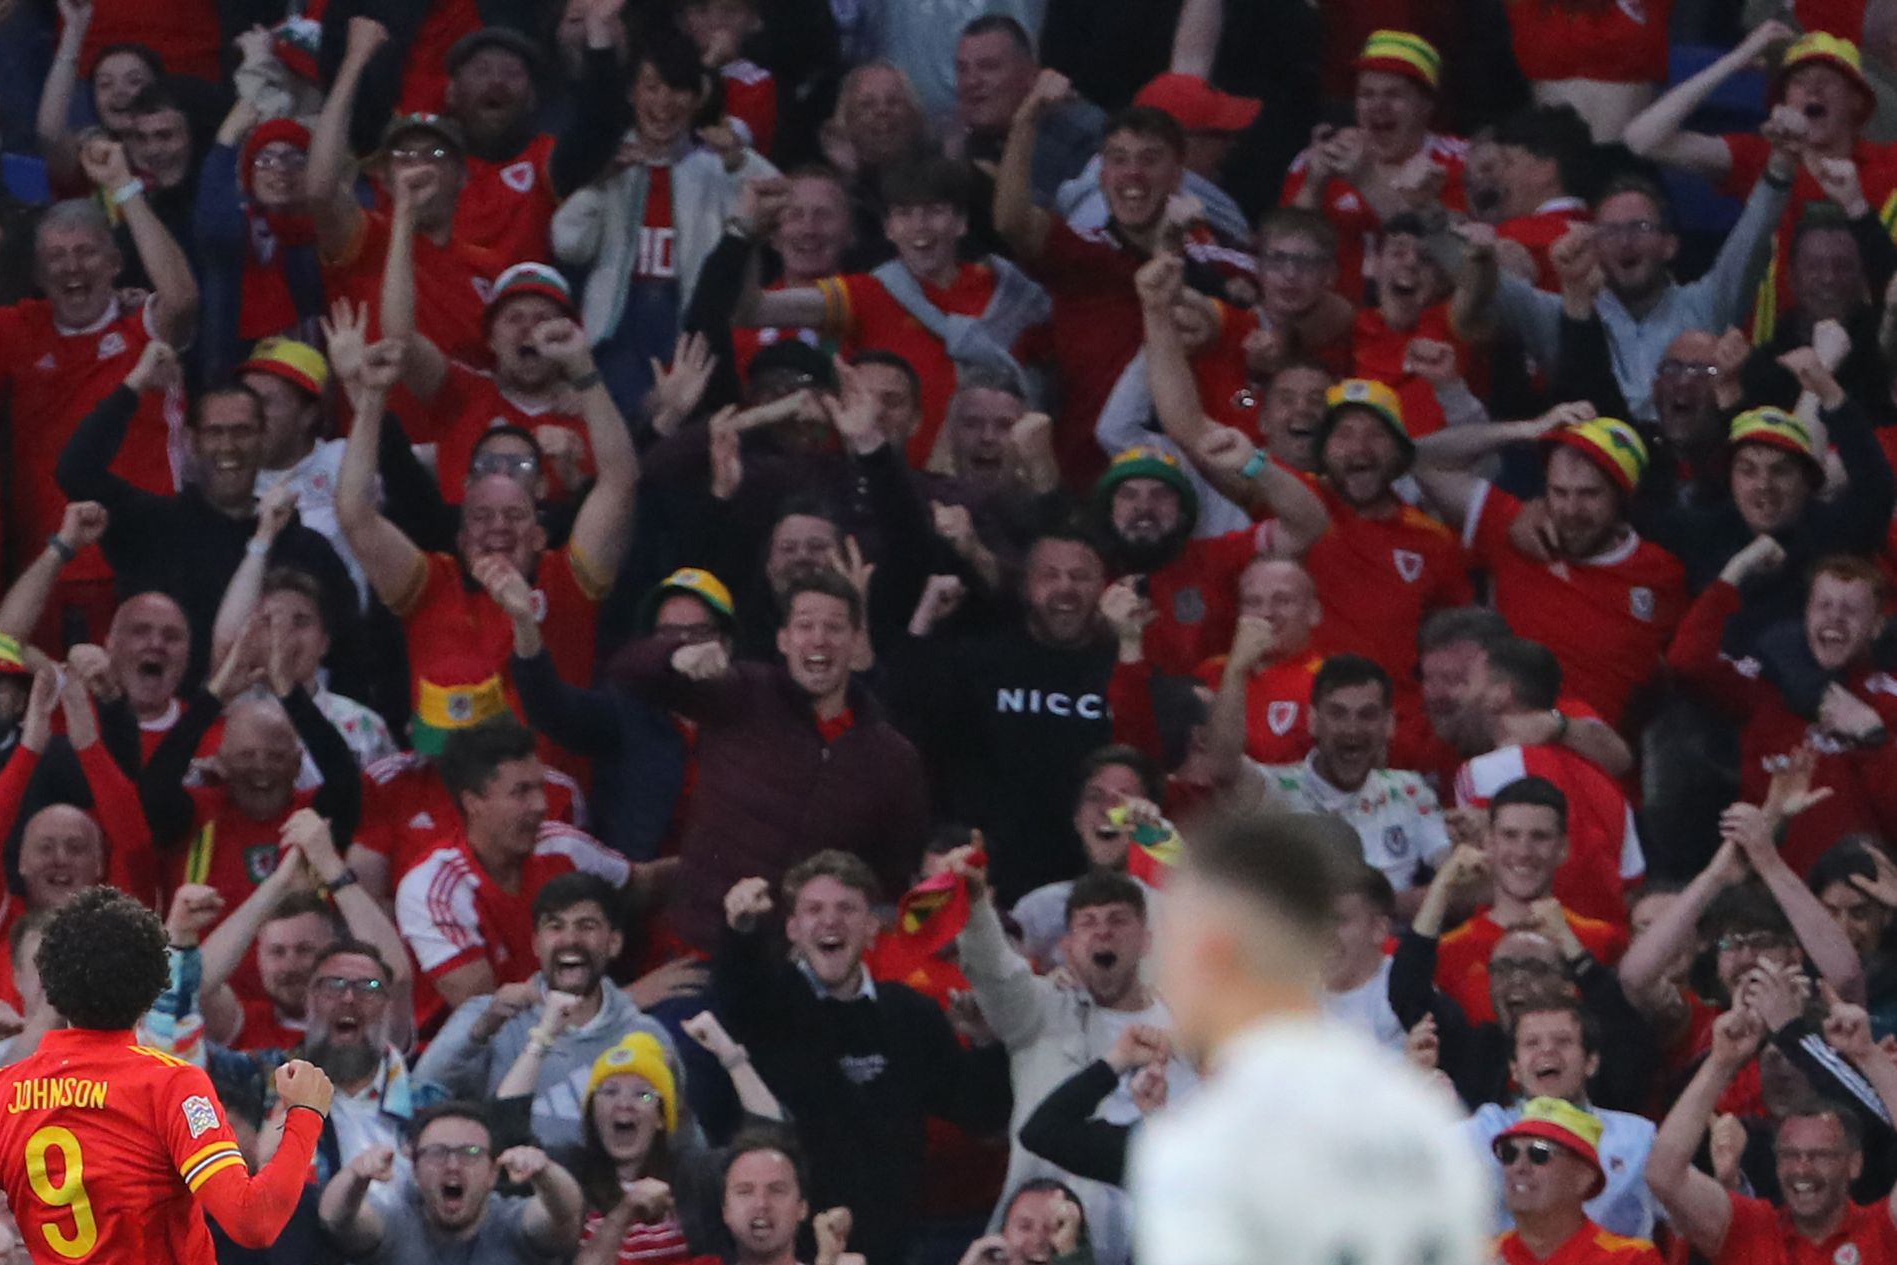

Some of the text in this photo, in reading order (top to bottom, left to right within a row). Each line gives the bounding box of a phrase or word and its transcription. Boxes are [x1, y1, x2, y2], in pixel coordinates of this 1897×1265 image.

[996, 687, 1115, 720] NICC
[8, 1077, 109, 1115] JOHNSON
[24, 1125, 98, 1259] 9
